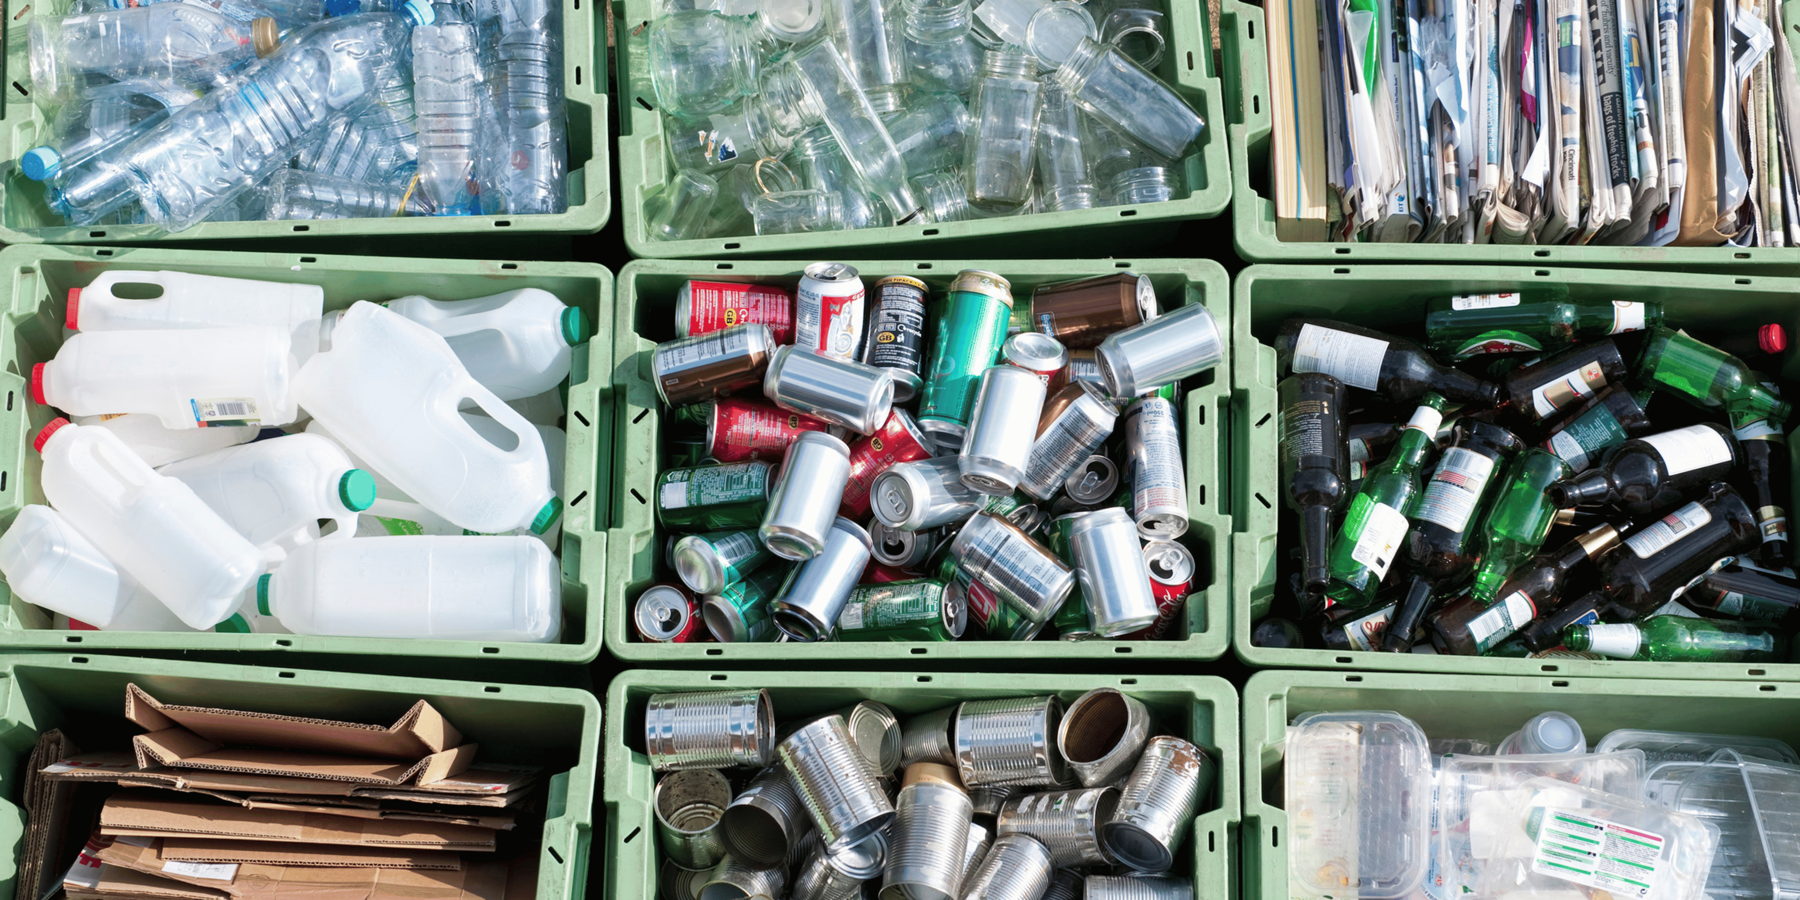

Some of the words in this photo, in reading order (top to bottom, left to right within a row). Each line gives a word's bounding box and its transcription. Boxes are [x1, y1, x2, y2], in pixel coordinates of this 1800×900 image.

[1604, 34, 1613, 48] and
[1603, 94, 1614, 116] bags
[1605, 115, 1616, 125] of
[1568, 148, 1576, 181] Cincinnati
[1610, 154, 1621, 179] frocks
[1398, 203, 1404, 212] BT
[726, 310, 734, 324] GB
[790, 416, 797, 428] GB
[872, 438, 883, 450] GB
